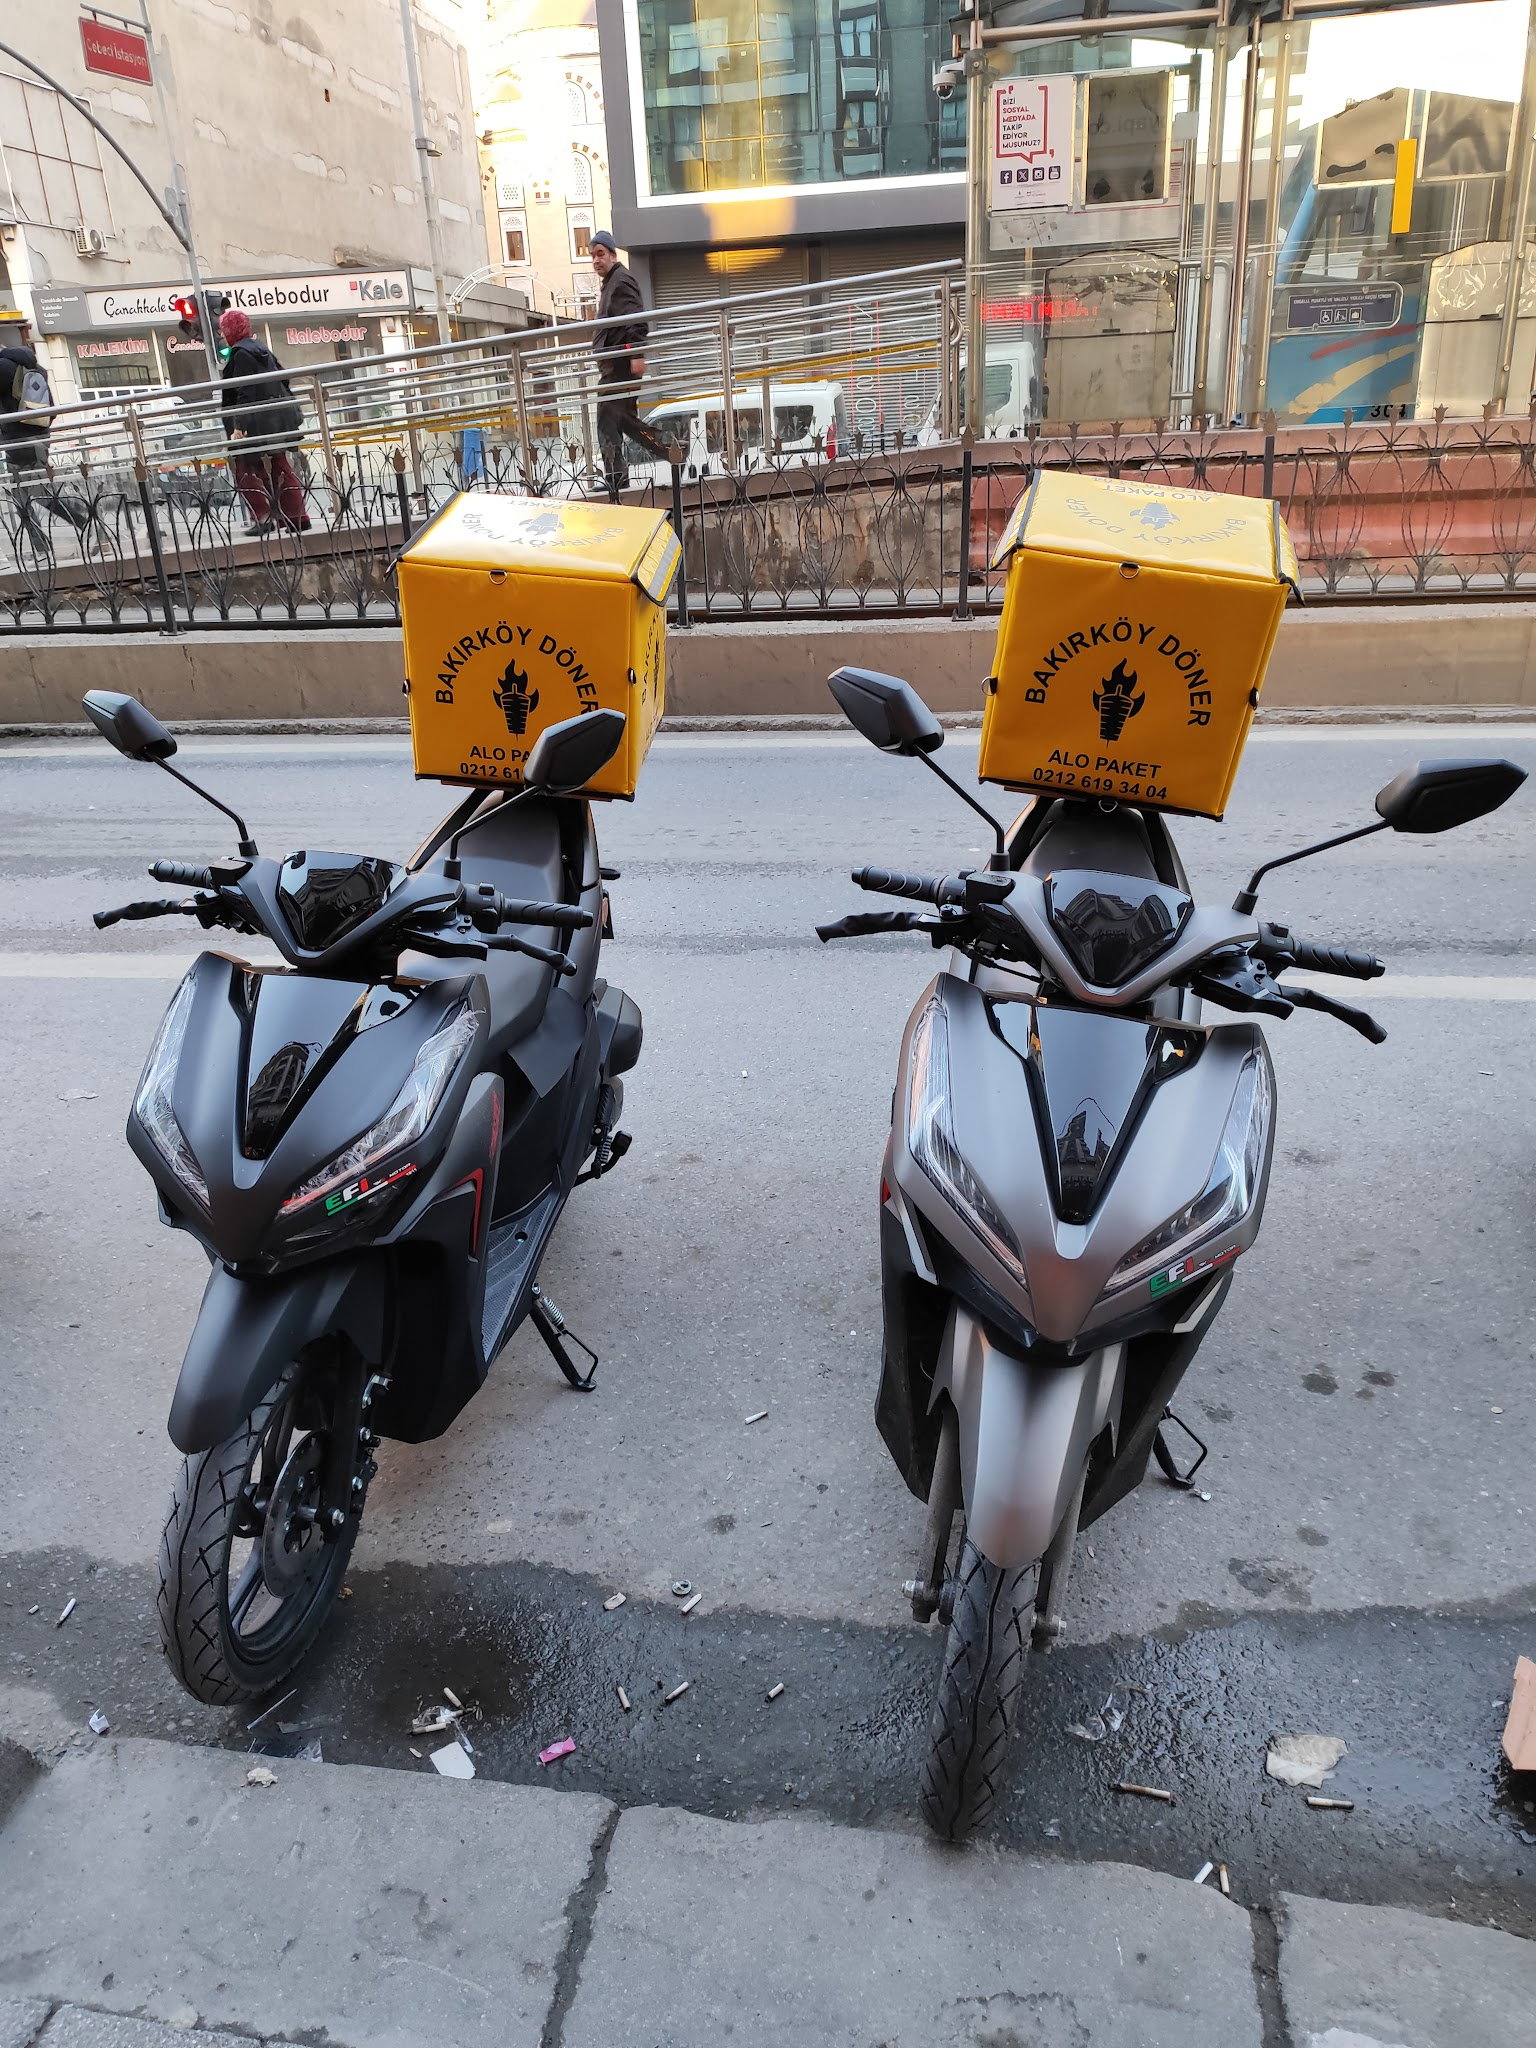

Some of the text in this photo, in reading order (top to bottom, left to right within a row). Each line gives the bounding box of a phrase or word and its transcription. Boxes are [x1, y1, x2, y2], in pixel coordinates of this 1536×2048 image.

[1002, 98, 1016, 106] BİZİ
[1002, 106, 1030, 114] SOSYAL
[1002, 114, 1036, 123] MEDYADA
[1002, 123, 1023, 132] TAKİP
[1002, 132, 1028, 140] EDİYOR
[1002, 139, 1041, 149] MUSUNUZ?
[234, 284, 330, 308] Kalebodur
[358, 279, 403, 301] Kale
[103, 296, 167, 318] Çanakkale
[286, 324, 368, 345] Kalebodur
[76, 337, 150, 358] KALEKİM
[1103, 484, 1213, 503] ALO PAKET
[435, 620, 599, 715] BAKIRKÖY DÖNER
[1024, 616, 1212, 727] BAKIRKÖY DÖNER
[469, 745, 531, 763] ALO PA
[1047, 749, 1162, 779] ALO PAKET
[460, 762, 524, 779] 0212 61
[1033, 767, 1168, 800] 0212 619 34 04
